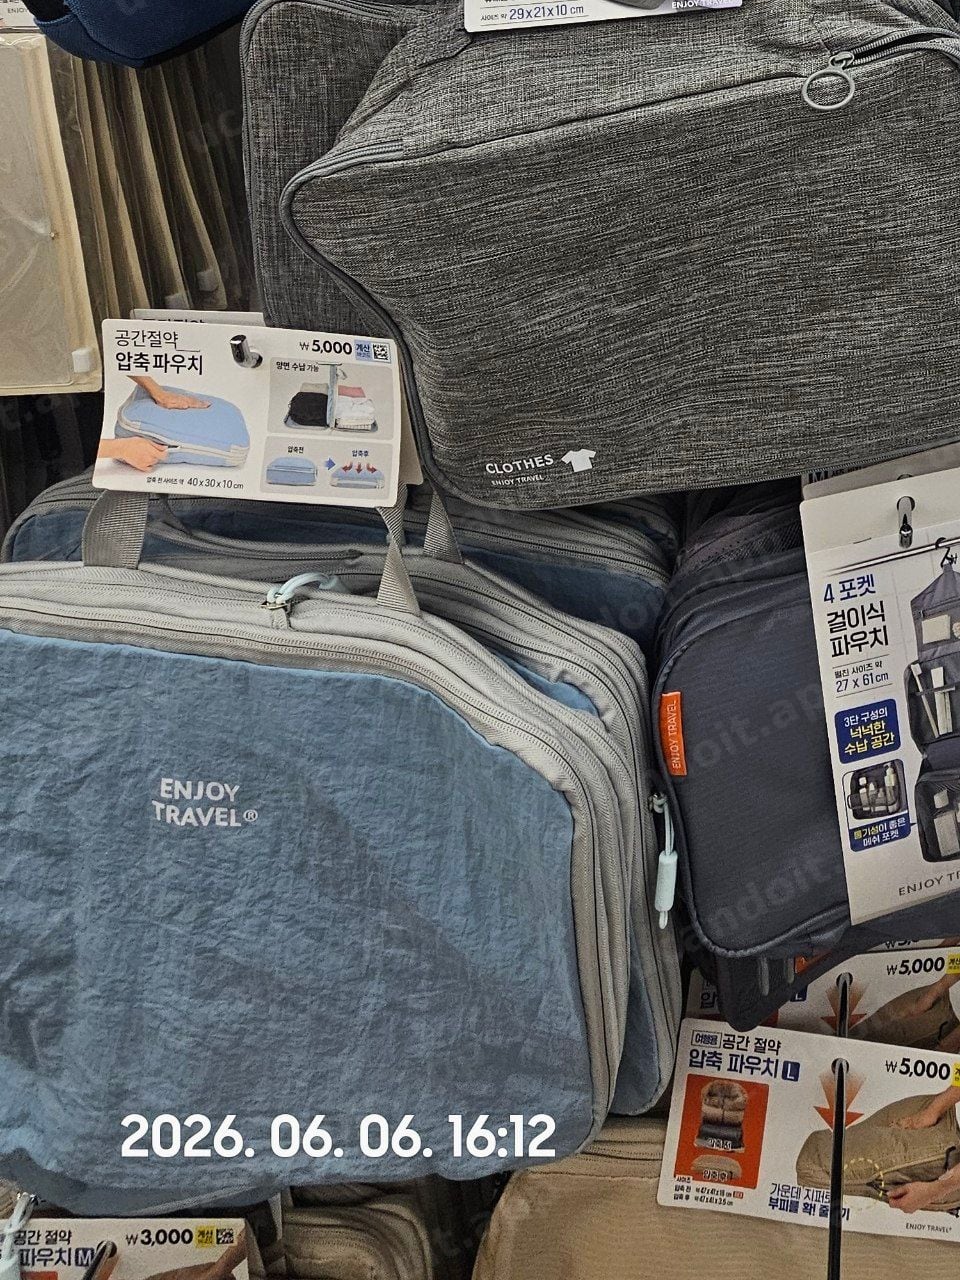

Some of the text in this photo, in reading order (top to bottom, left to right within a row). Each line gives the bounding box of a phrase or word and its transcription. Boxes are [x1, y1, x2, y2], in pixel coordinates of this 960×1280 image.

[570, 5, 584, 14] cm
[672, 0, 699, 9] ENJOY
[115, 330, 178, 349] 공간절약
[356, 344, 370, 352] 계산
[116, 352, 203, 375] 압축 파우치
[292, 363, 305, 371] 수납
[486, 454, 554, 474] CLOTHES
[516, 475, 545, 485] TRAVEL
[824, 574, 876, 603] 4 포켓
[827, 601, 885, 632] 걸이식
[830, 625, 889, 658] 파우치
[851, 663, 874, 676] 사이즈
[836, 678, 848, 693] 27
[844, 707, 888, 727] 3단 구성의
[666, 700, 681, 769] ENJOY TRAVEL
[850, 721, 886, 739] 넉넉한
[844, 732, 895, 756] 수납 공간
[160, 777, 240, 802] ENJOY
[882, 830, 900, 842] 포켓
[898, 875, 944, 896] ENJOY
[723, 1033, 750, 1051] 공간
[754, 1037, 782, 1056] 절약
[689, 1049, 722, 1071] 압축
[727, 1053, 779, 1078] 파우치
[770, 1183, 801, 1199] 가운데
[768, 1197, 799, 1213] 부피를
[802, 1203, 815, 1216] 확!
[906, 1222, 925, 1231] ENJOY
[14, 1230, 72, 1246] 공간 절약
[20, 1248, 71, 1267] 파우치
